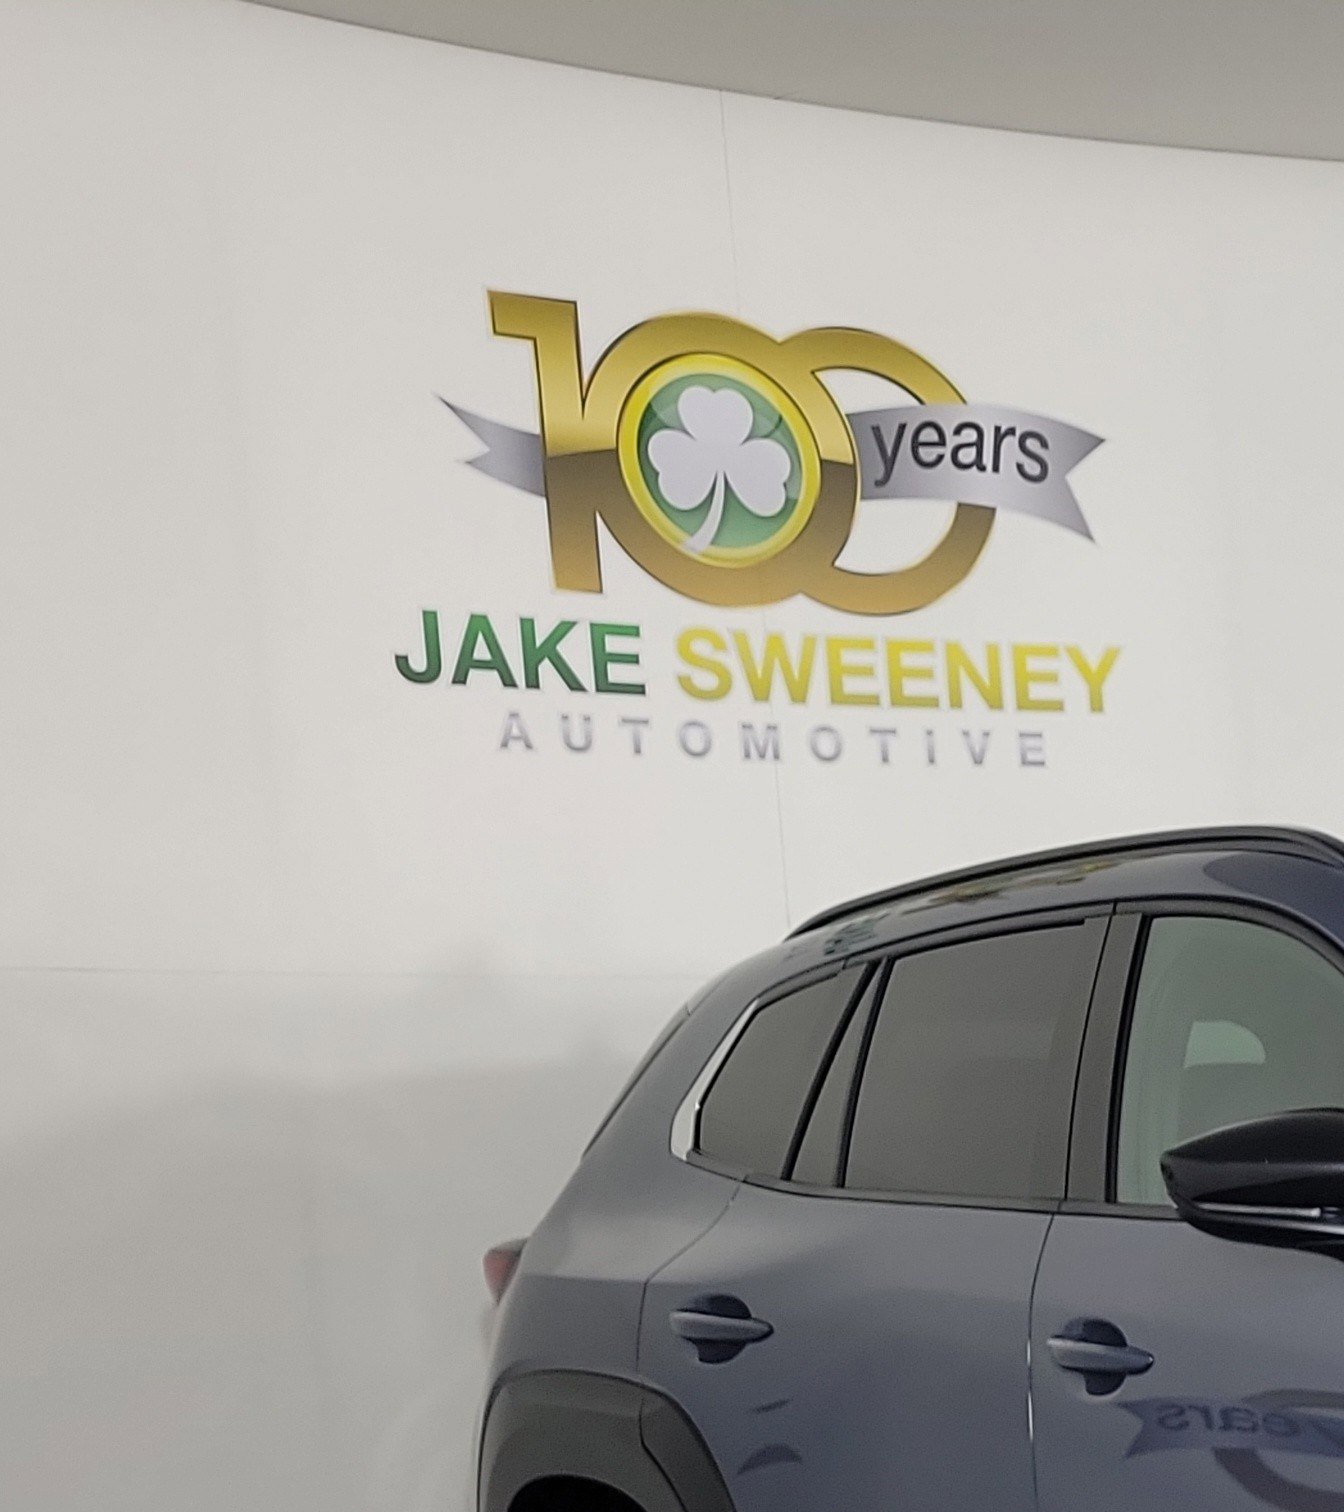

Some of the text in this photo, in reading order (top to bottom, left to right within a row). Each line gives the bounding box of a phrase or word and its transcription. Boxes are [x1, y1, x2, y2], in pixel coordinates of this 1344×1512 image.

[869, 418, 1051, 488] years
[394, 610, 1122, 714] JAKE SWEENEY
[498, 713, 1048, 767] AUTOMOTIVE
